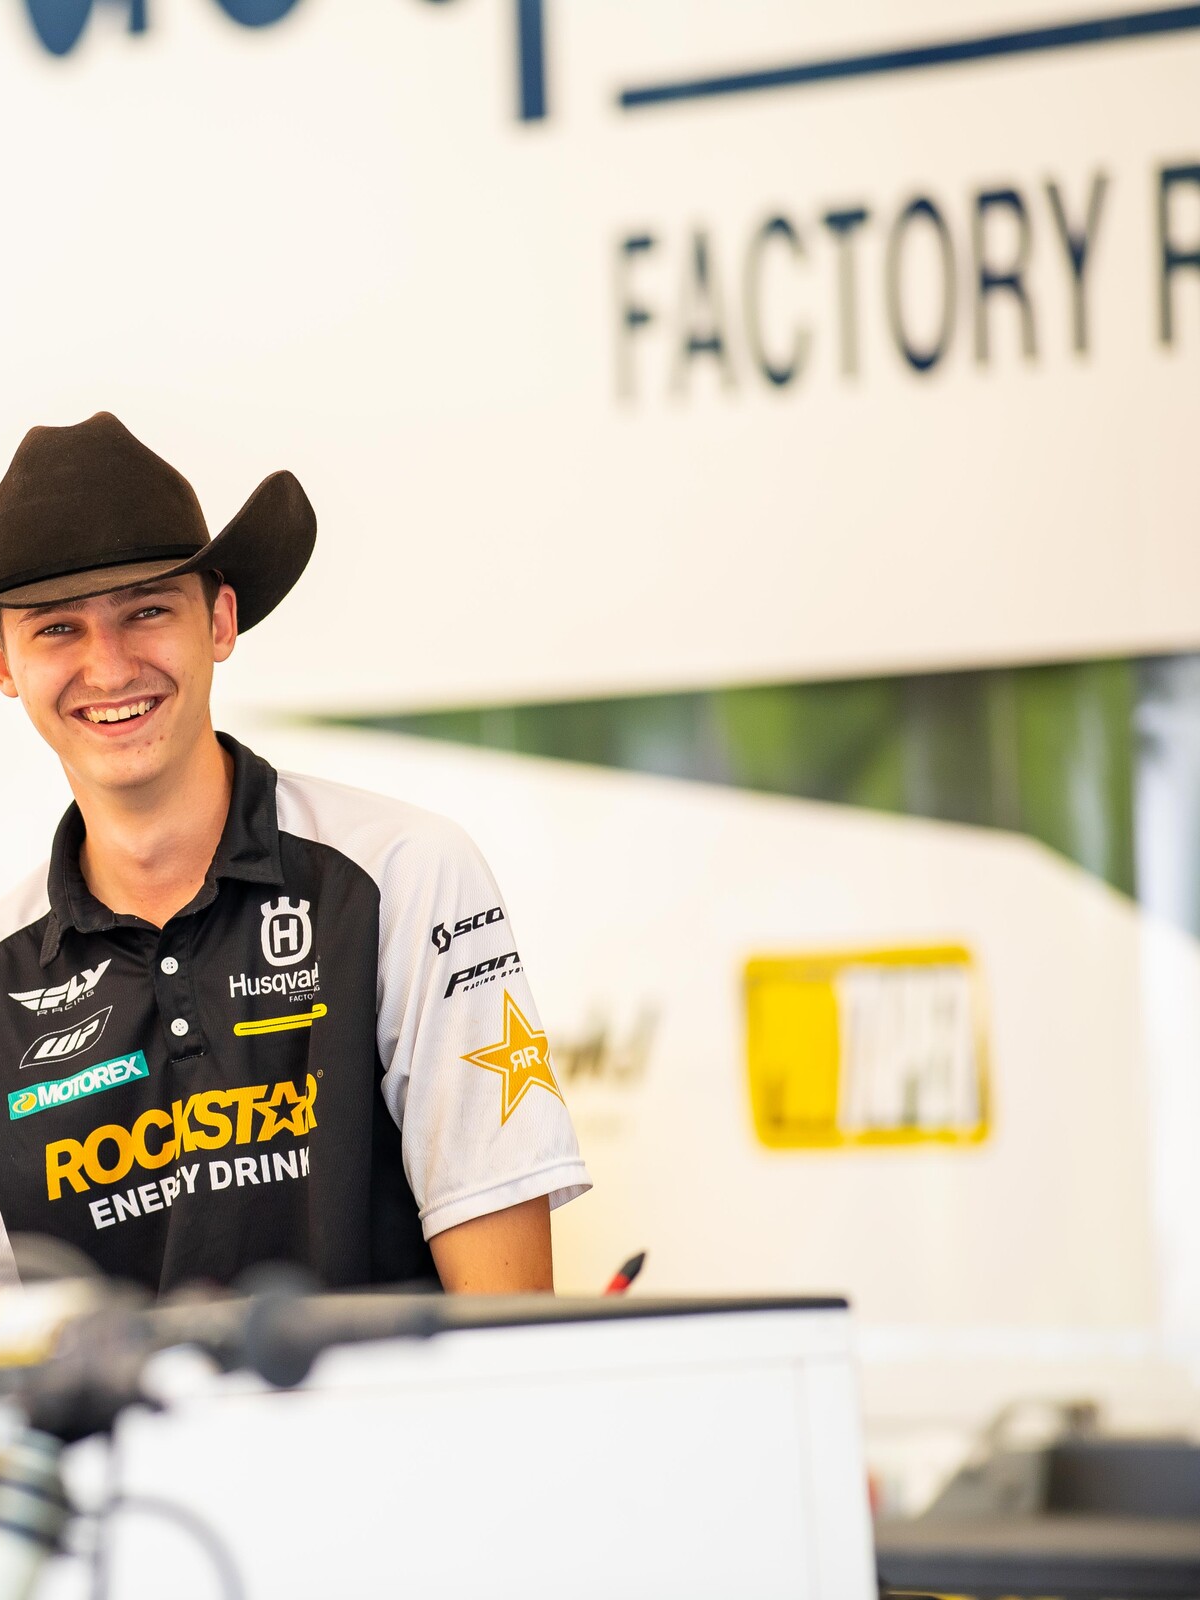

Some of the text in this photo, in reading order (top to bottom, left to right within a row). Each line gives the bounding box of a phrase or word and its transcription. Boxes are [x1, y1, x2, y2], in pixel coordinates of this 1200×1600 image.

[610, 170, 1108, 400] FACTORY
[8, 958, 112, 1011] FLY
[36, 989, 95, 1016] RACING
[289, 993, 315, 1003] FACTO
[462, 966, 524, 993] RACING SYS
[37, 1055, 143, 1107] MOTOREX
[45, 1073, 319, 1201] ROCKSTAR
